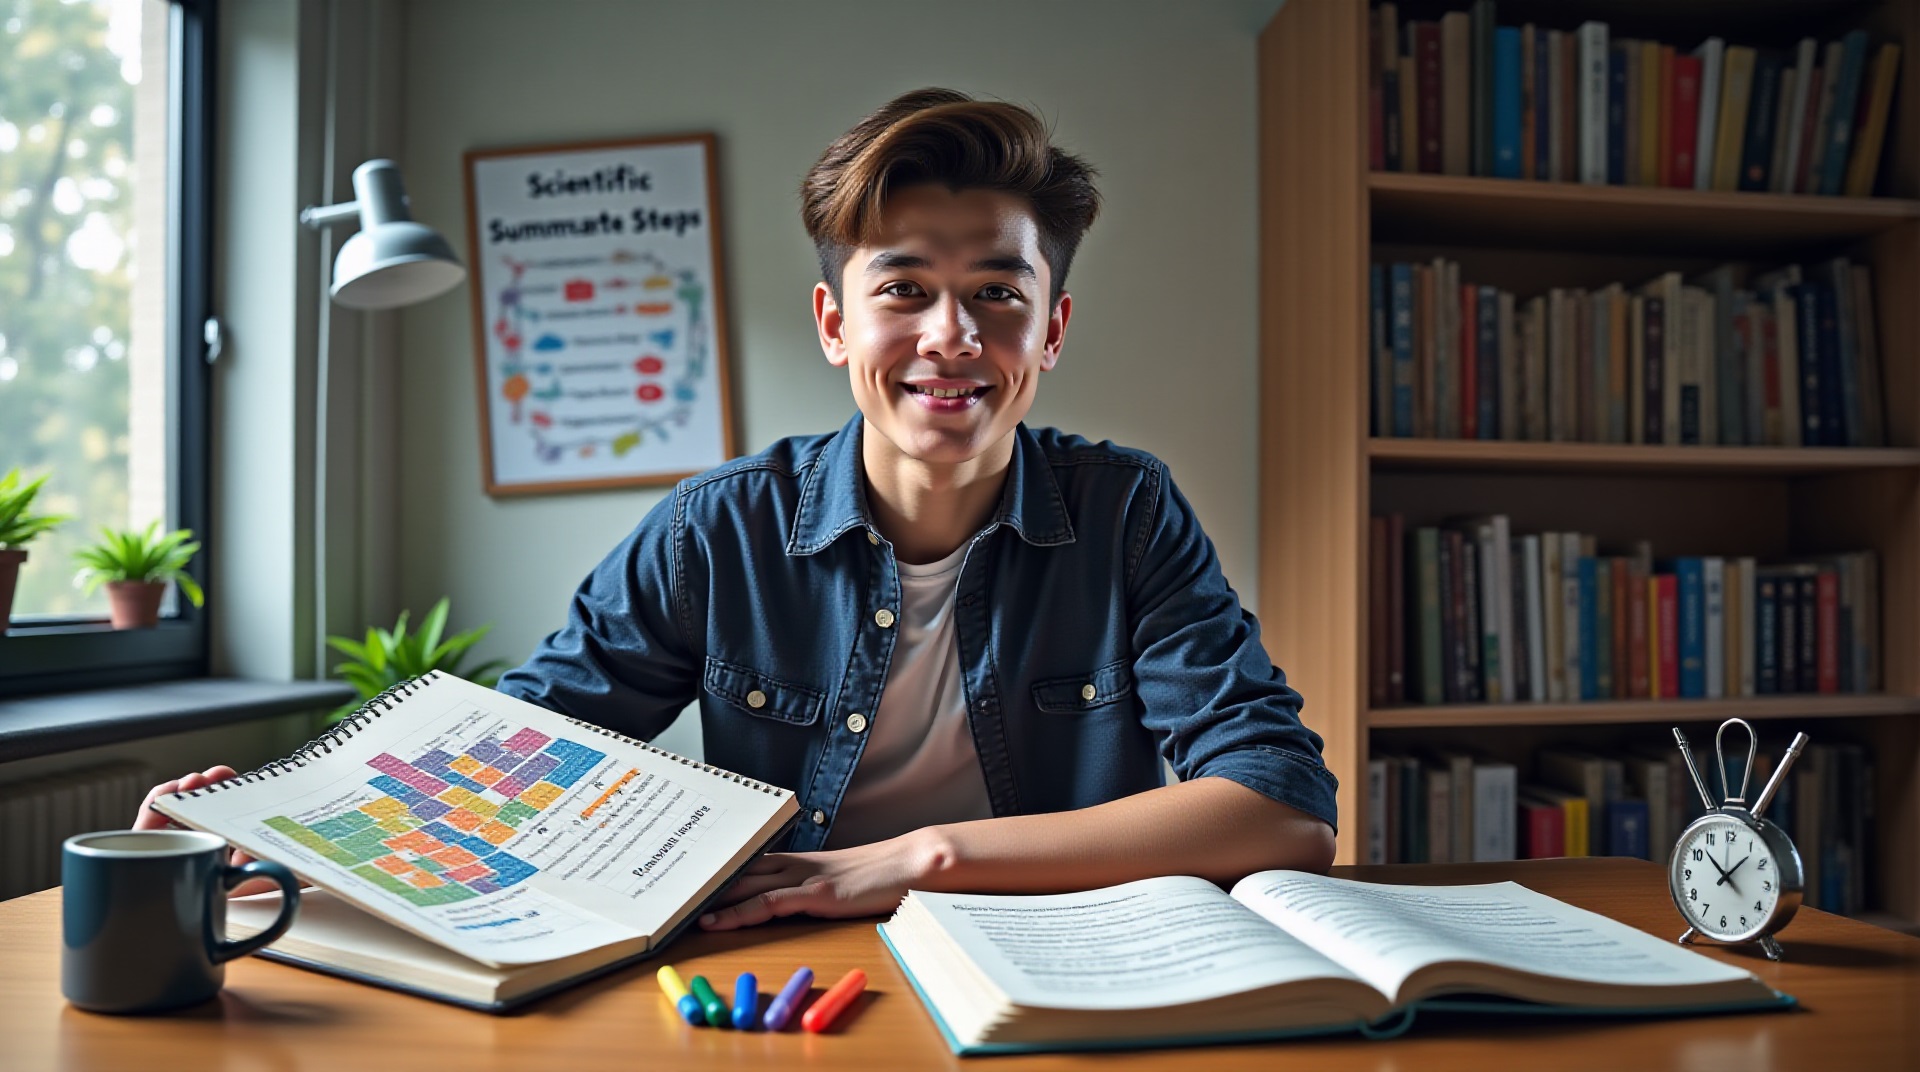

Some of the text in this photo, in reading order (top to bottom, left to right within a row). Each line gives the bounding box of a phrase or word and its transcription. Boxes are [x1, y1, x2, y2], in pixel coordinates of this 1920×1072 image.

[527, 164, 653, 198] Scientific
[631, 207, 701, 238] Steps
[1693, 849, 1703, 861] 10
[1685, 869, 1692, 880] 9
[1690, 889, 1697, 900] 8
[1702, 903, 1710, 917] 7
[1754, 901, 1762, 911] 4
[1720, 915, 1727, 927] 6
